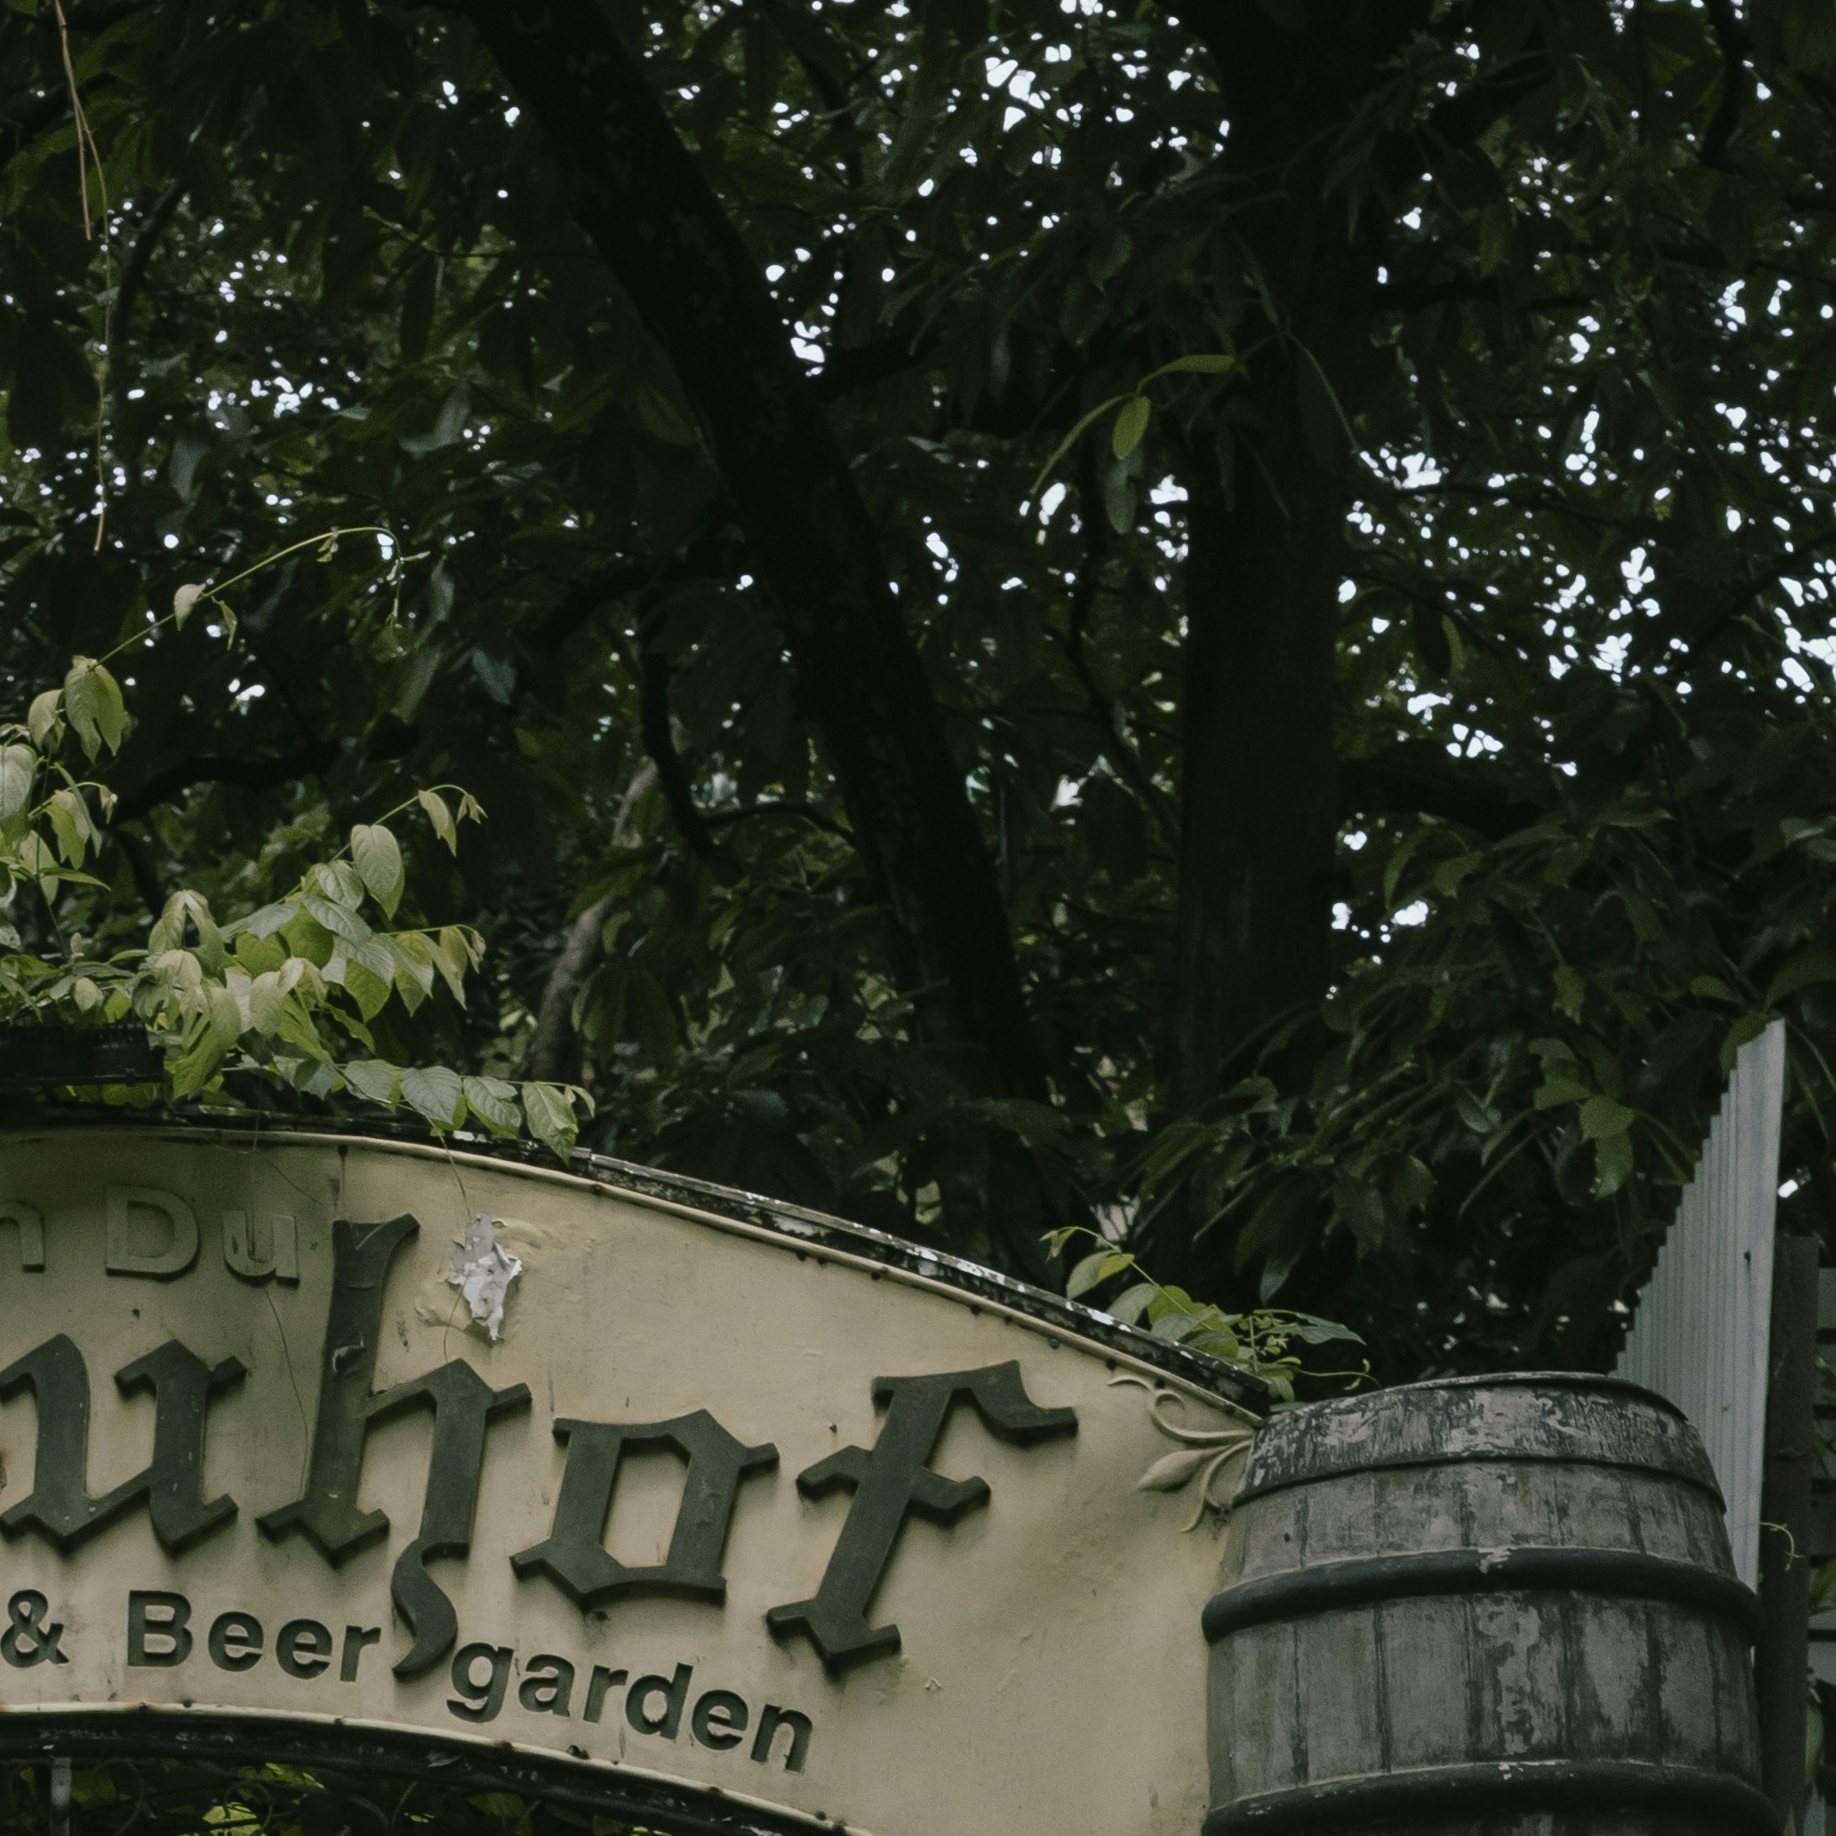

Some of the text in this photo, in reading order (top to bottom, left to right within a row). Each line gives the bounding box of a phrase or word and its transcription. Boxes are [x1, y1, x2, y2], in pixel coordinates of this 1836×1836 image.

[104, 1184, 301, 1286] Du
[0, 1588, 71, 1670] &
[126, 1589, 382, 1684] Beer
[446, 1640, 815, 1776] garden
